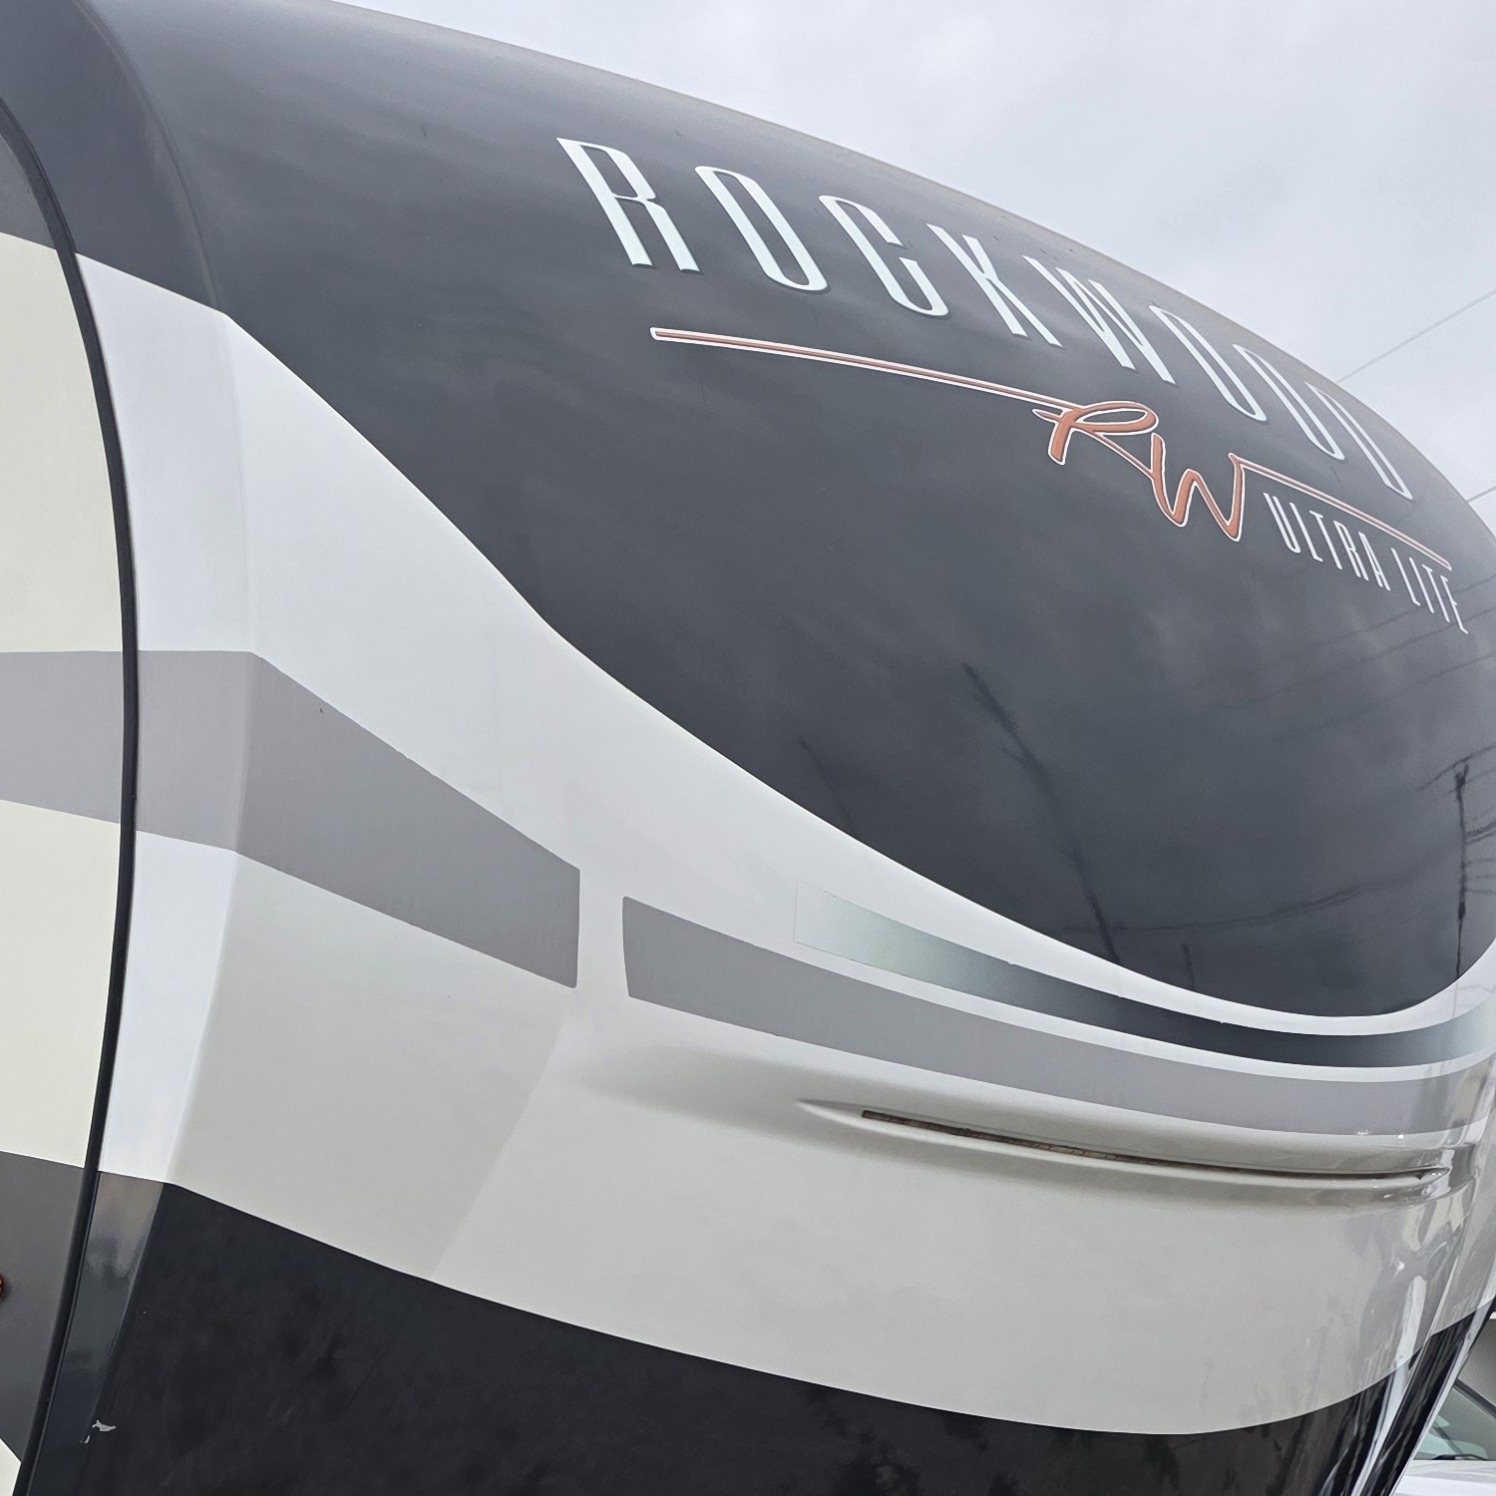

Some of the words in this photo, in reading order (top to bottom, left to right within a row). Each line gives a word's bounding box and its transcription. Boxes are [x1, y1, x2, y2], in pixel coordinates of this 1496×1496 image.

[556, 137, 1414, 501] ROCKWOOD
[1262, 491, 1391, 592] ULTRA
[1390, 547, 1470, 635] LITE
